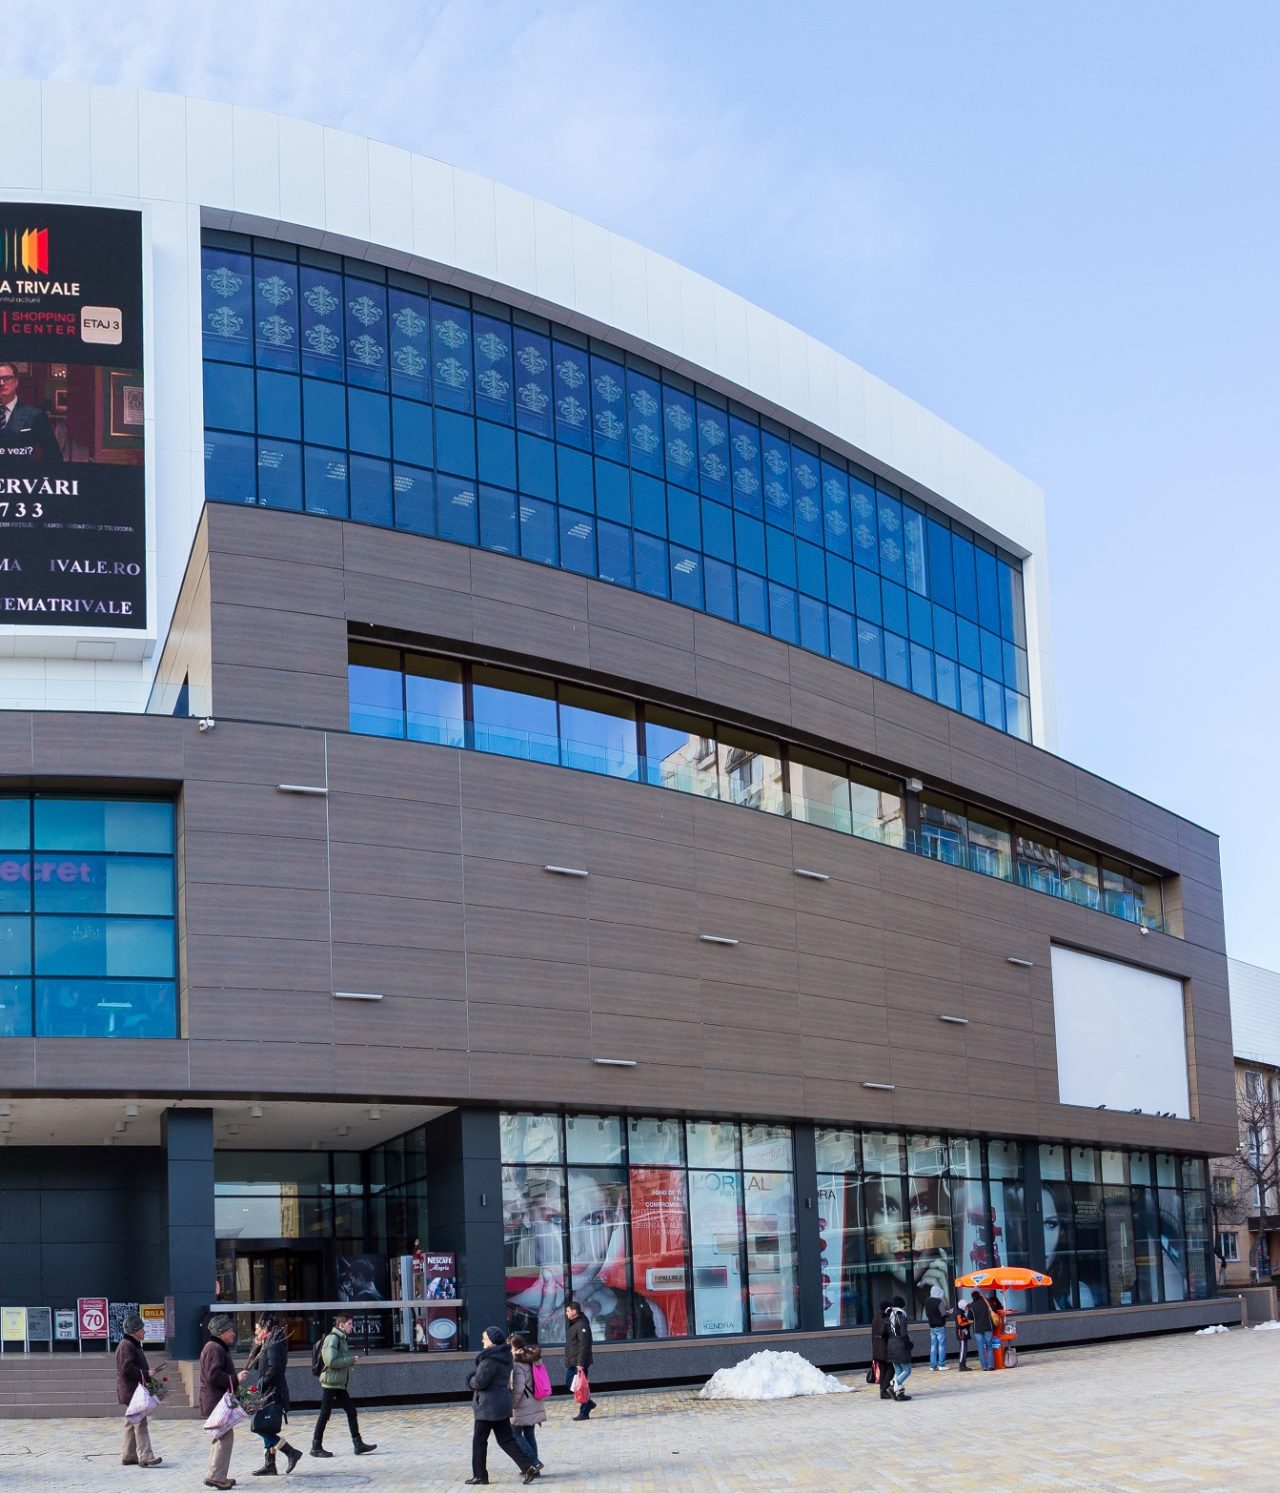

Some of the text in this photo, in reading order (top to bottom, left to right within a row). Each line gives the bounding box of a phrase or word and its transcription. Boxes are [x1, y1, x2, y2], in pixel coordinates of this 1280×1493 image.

[16, 281, 80, 296] TRIVALE
[12, 311, 76, 323] SHOPPING
[12, 323, 76, 335] CENTER
[83, 319, 120, 331] ETAJ 3
[7, 446, 33, 456] vezi?
[693, 1173, 772, 1191] L'ORAL
[86, 1314, 102, 1327] 70
